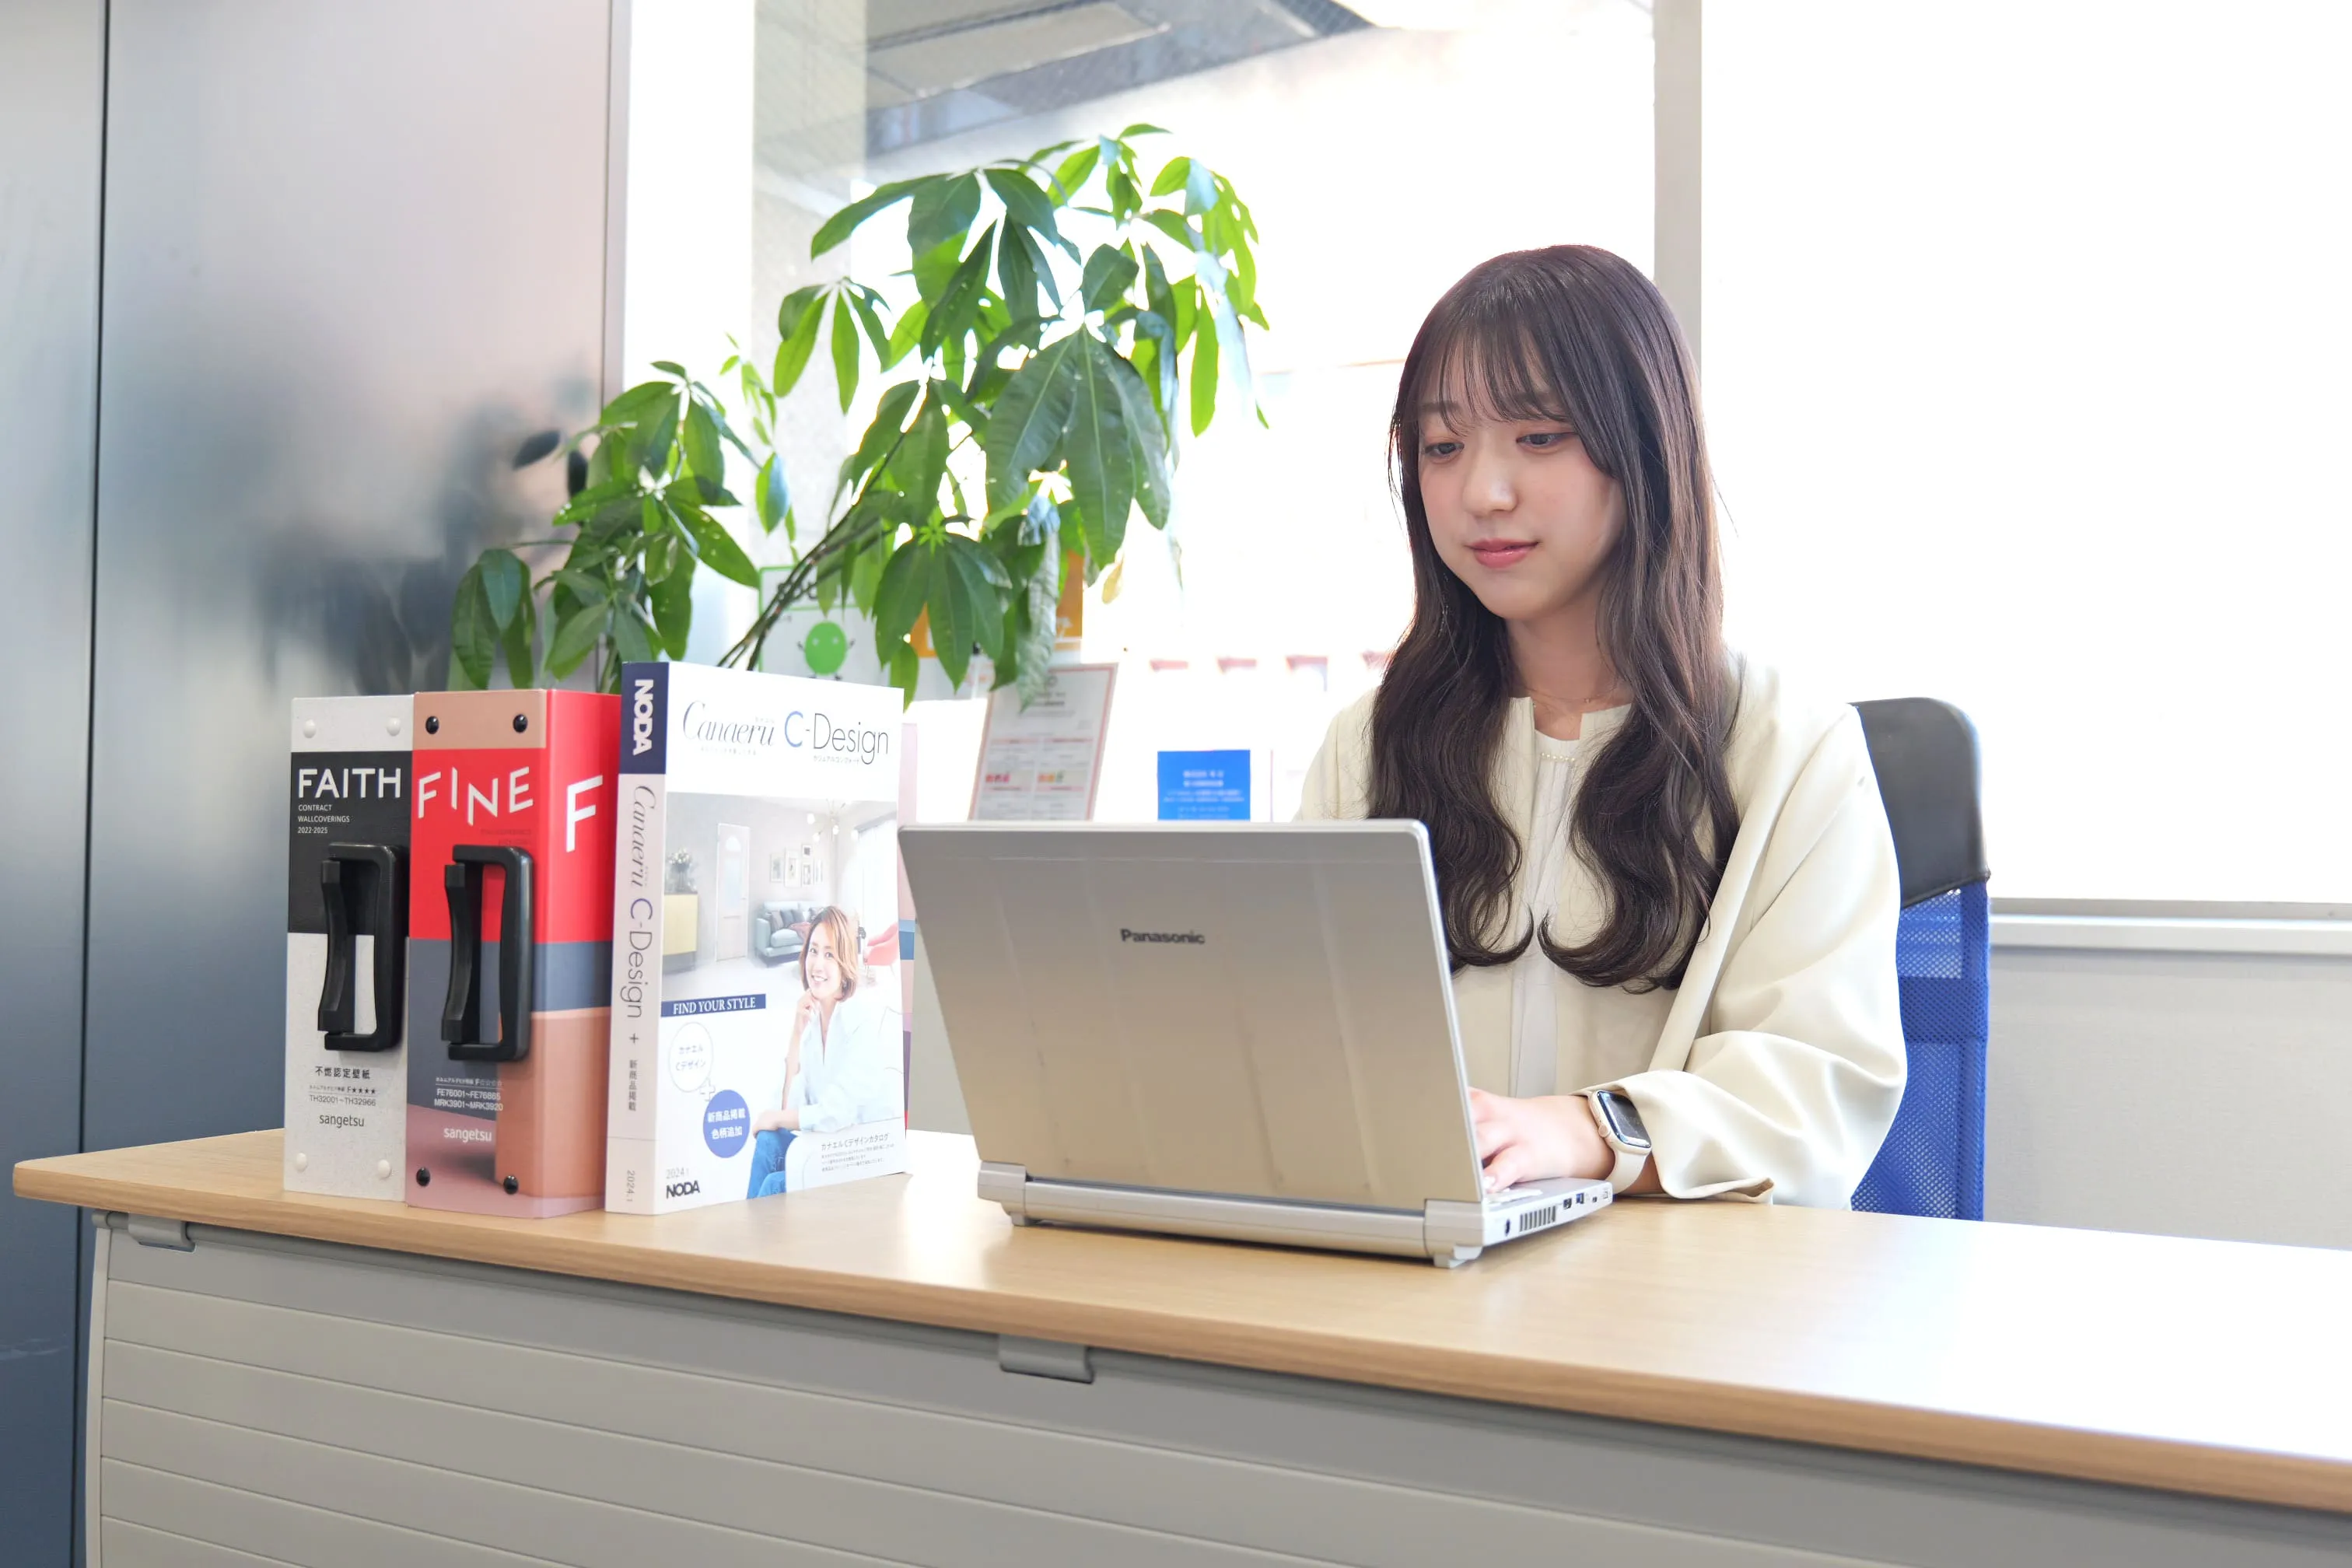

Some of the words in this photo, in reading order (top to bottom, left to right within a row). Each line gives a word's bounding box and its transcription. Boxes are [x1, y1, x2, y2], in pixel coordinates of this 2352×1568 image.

[632, 678, 654, 756] NODA
[682, 700, 776, 747] Canaeru
[784, 710, 889, 765] C-Design
[298, 768, 401, 799] FAITH
[418, 766, 534, 826] FINE
[298, 803, 332, 812] CONTRACT
[298, 815, 350, 824] WALLCOVERINGS
[565, 775, 604, 853] F
[631, 785, 656, 887] Canaeru
[1120, 928, 1206, 945] Panasonic
[620, 898, 653, 1019] C-Design
[673, 1001, 697, 1015] FIND
[698, 999, 727, 1013] YOUR
[727, 996, 756, 1010] STYLE
[319, 1114, 365, 1129] sangetsu
[443, 1127, 492, 1143] sangetsu
[666, 1180, 701, 1199] NODA
